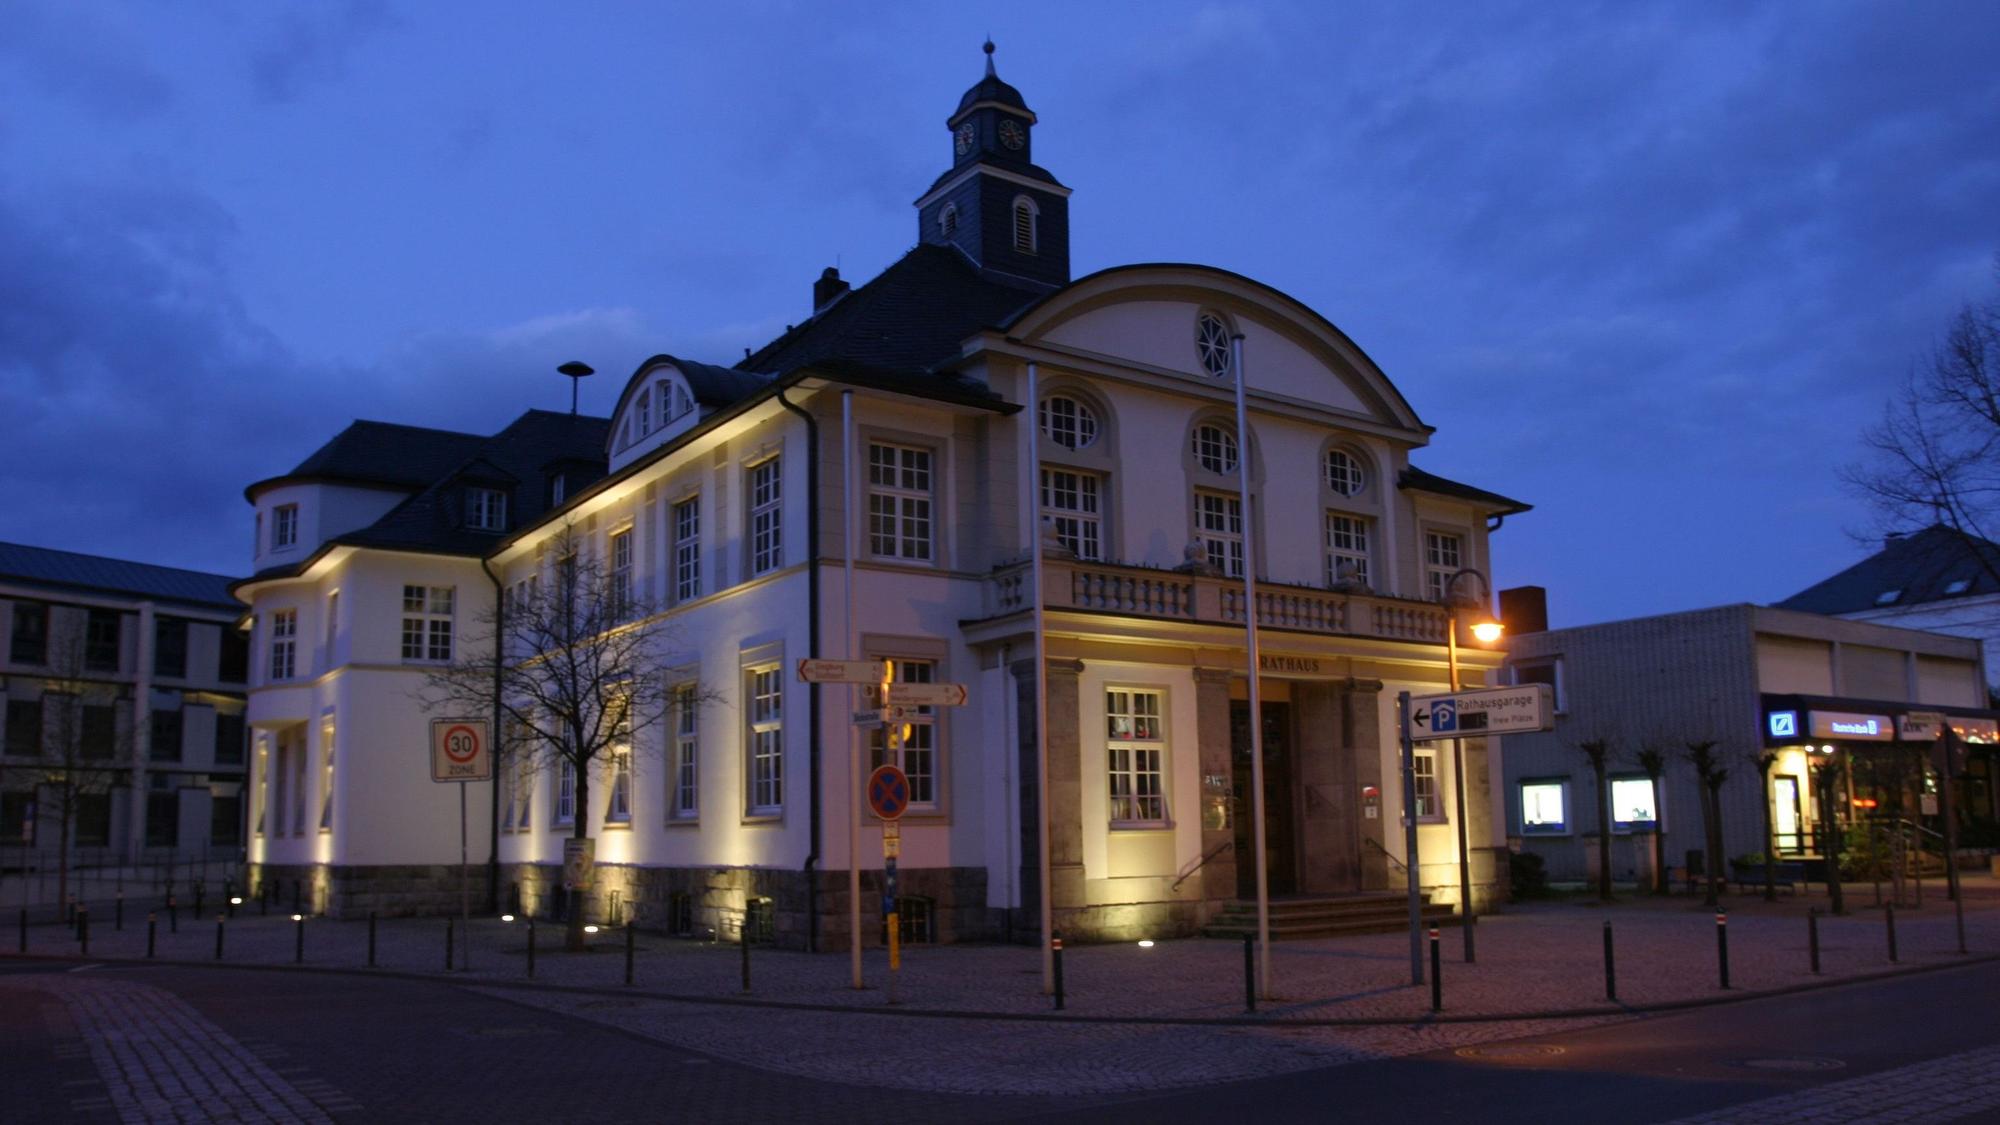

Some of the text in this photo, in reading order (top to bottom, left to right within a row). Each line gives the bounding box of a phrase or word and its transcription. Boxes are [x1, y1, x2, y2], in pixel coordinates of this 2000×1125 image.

[1260, 655, 1319, 672] RATHAUS
[1457, 695, 1532, 710] Rathausgarage
[1439, 711, 1450, 729] P
[450, 735, 472, 752] 30
[448, 764, 475, 775] ZONE
